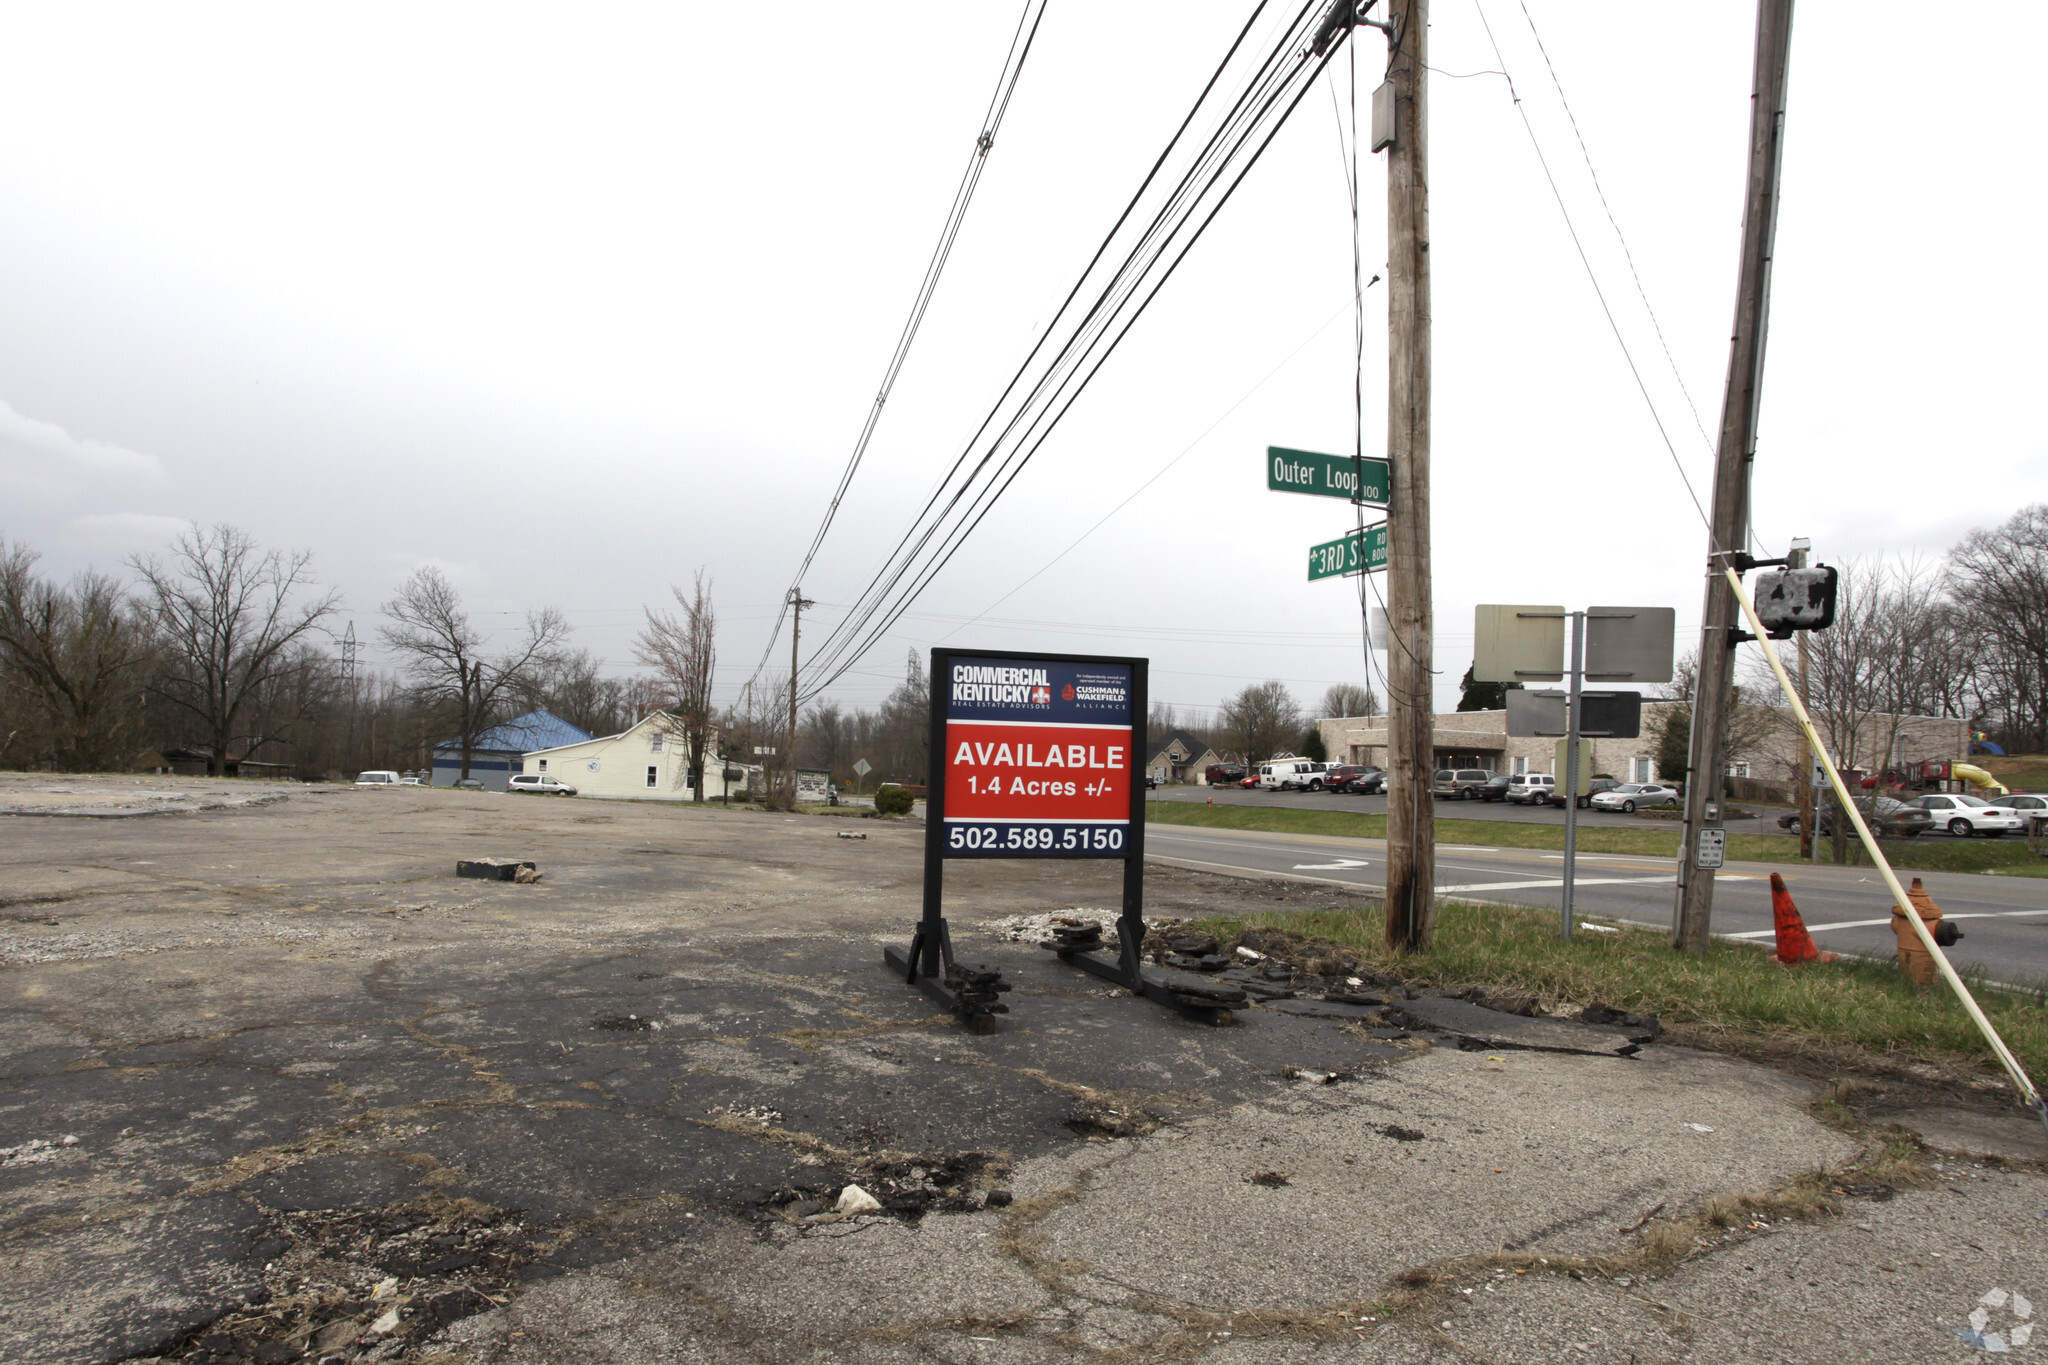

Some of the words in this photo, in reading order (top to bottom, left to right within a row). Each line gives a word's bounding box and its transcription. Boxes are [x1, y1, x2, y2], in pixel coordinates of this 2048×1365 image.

[1274, 457, 1315, 485] Outer
[1326, 463, 1358, 496] Loop
[1363, 485, 1379, 499] 100
[1377, 532, 1386, 546] RD
[1318, 544, 1345, 574] 3RD
[953, 665, 1050, 686] COMMERCIAL
[953, 684, 1031, 703] KENTUCKY
[1076, 686, 1119, 694] CUSHMAN
[1076, 693, 1124, 701] WAKEFIELD
[953, 741, 1124, 769] AVAILABLE
[967, 775, 1001, 795] 1.4
[1009, 776, 1076, 796] Acres
[1084, 777, 1112, 797] +/-
[950, 827, 1123, 850] 502.589.5150
